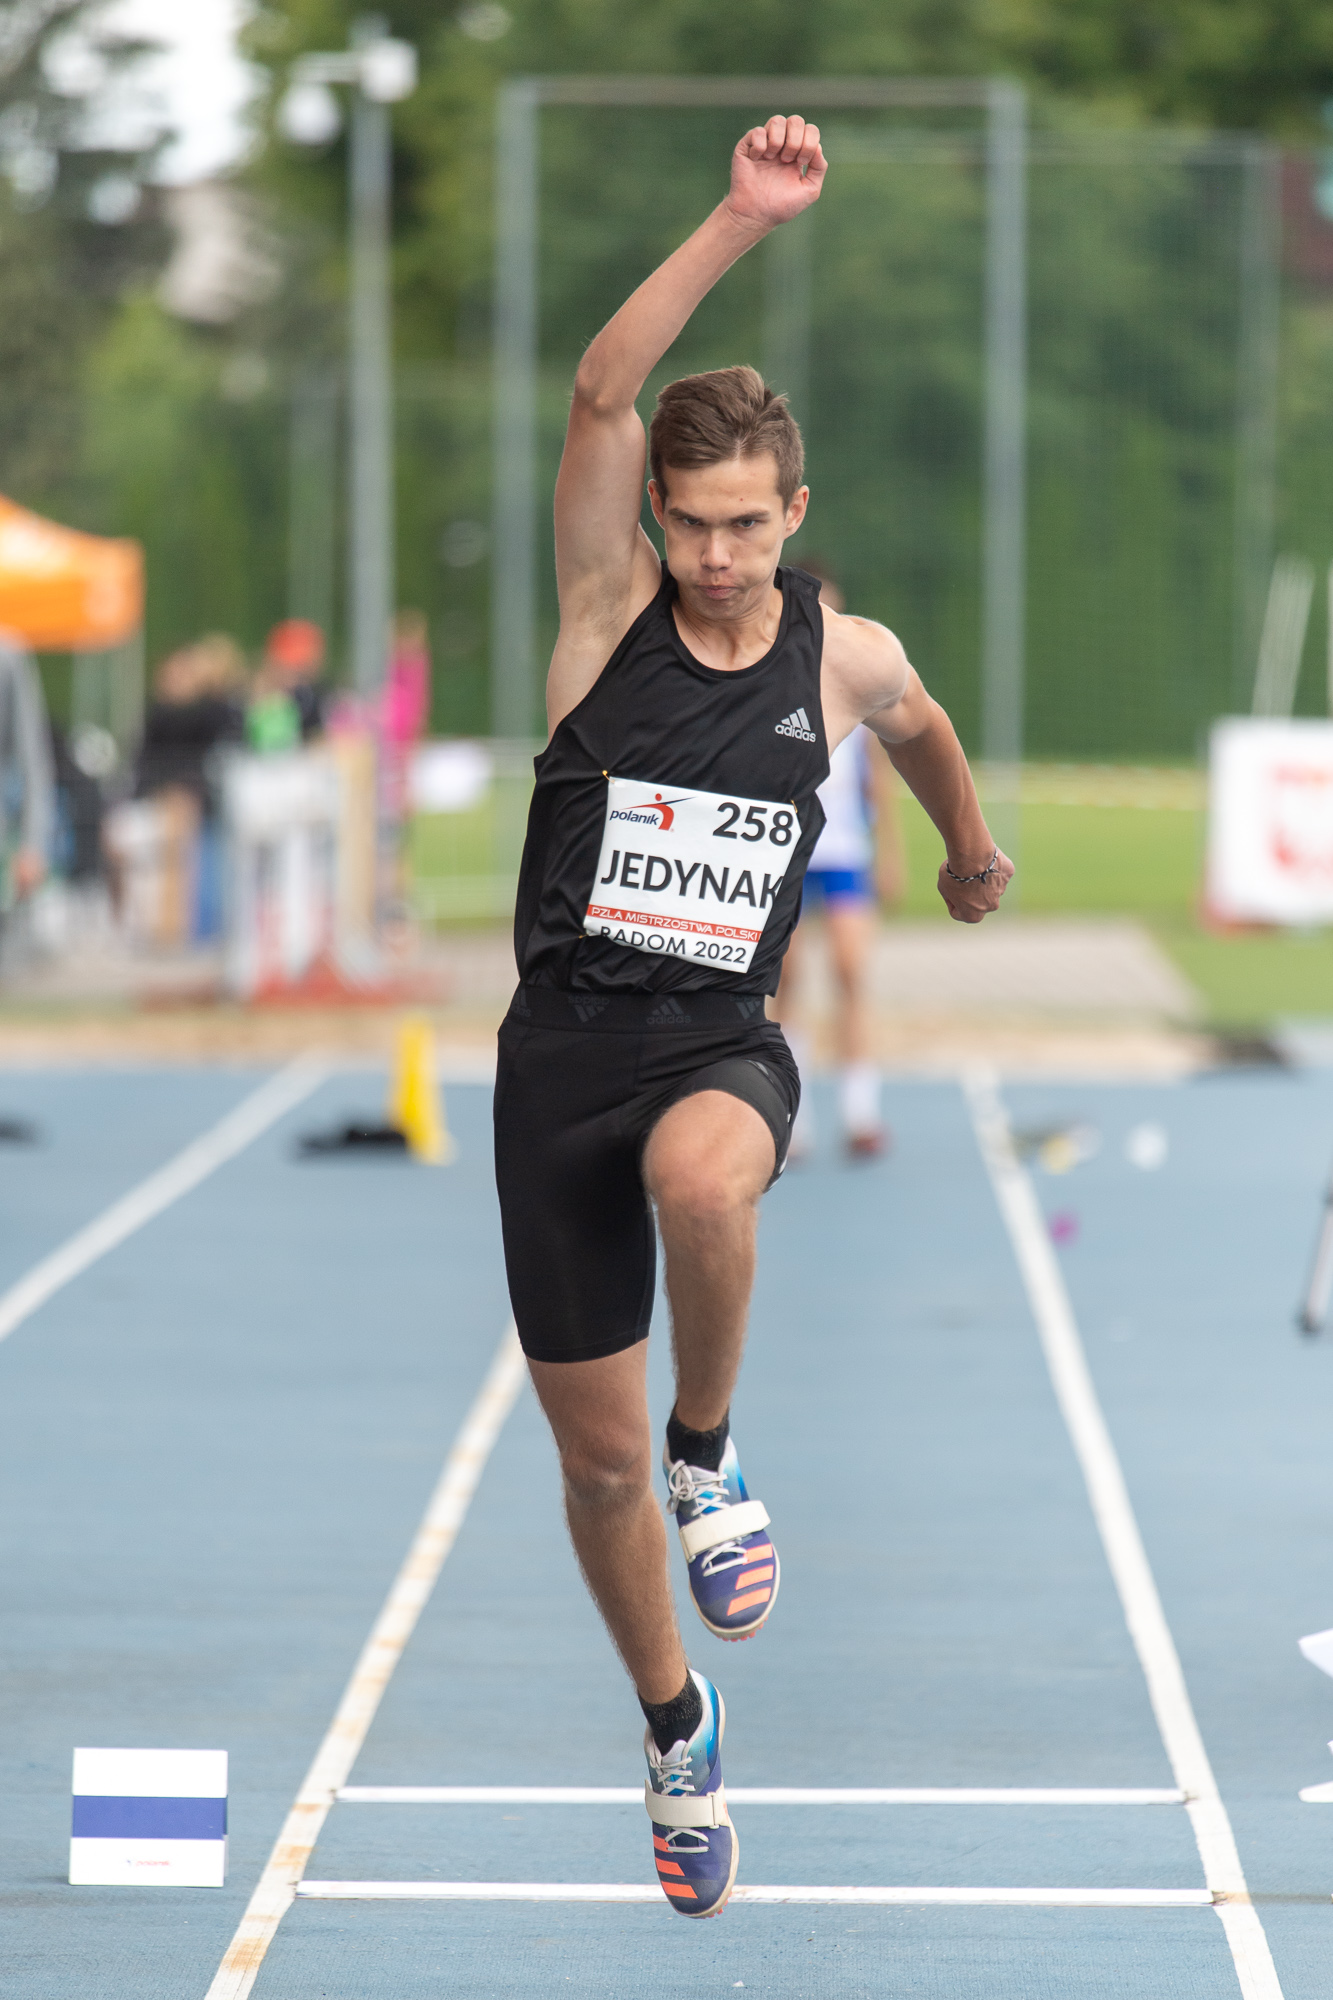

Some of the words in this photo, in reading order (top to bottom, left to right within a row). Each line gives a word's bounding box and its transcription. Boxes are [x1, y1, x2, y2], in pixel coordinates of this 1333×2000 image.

[774, 724, 817, 743] adidas
[608, 809, 660, 827] polanik
[712, 801, 794, 847] 258
[600, 849, 785, 909] JEDYNAK
[591, 906, 623, 921] PZLA
[625, 911, 713, 935] MISTRZOSTWA
[715, 926, 758, 941] POLSKI
[600, 926, 686, 955] RADOM
[693, 941, 747, 965] 2022
[646, 1014, 692, 1025] adidas
